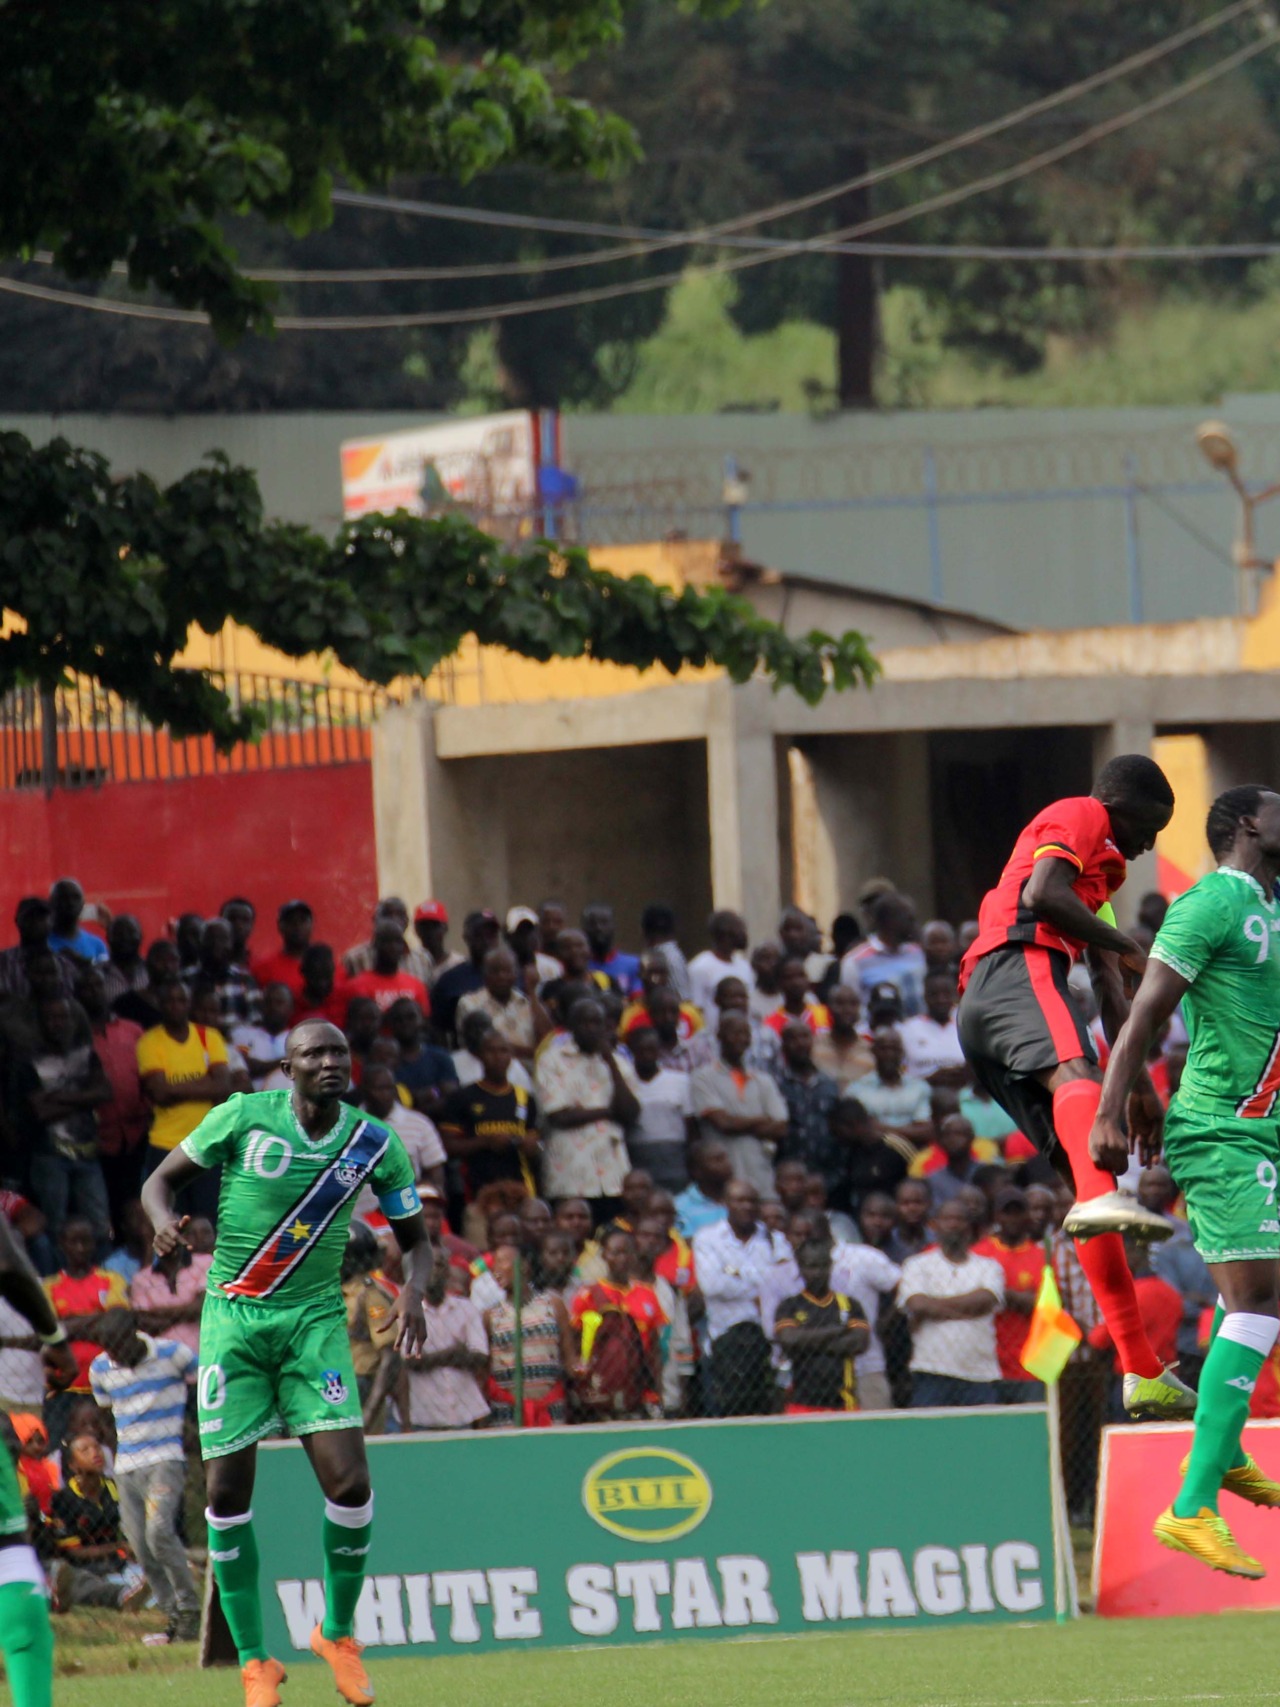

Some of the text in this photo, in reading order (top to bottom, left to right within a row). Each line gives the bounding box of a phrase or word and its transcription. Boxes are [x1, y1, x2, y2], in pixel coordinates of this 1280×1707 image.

[1243, 914, 1269, 965] 9
[242, 1128, 293, 1179] 10
[400, 1187, 416, 1211] C
[1256, 1160, 1278, 1206] 9
[1129, 1379, 1184, 1407] NIKE
[597, 1480, 702, 1511] BUL
[276, 1540, 1044, 1650] WHITE STAR MAGIC
